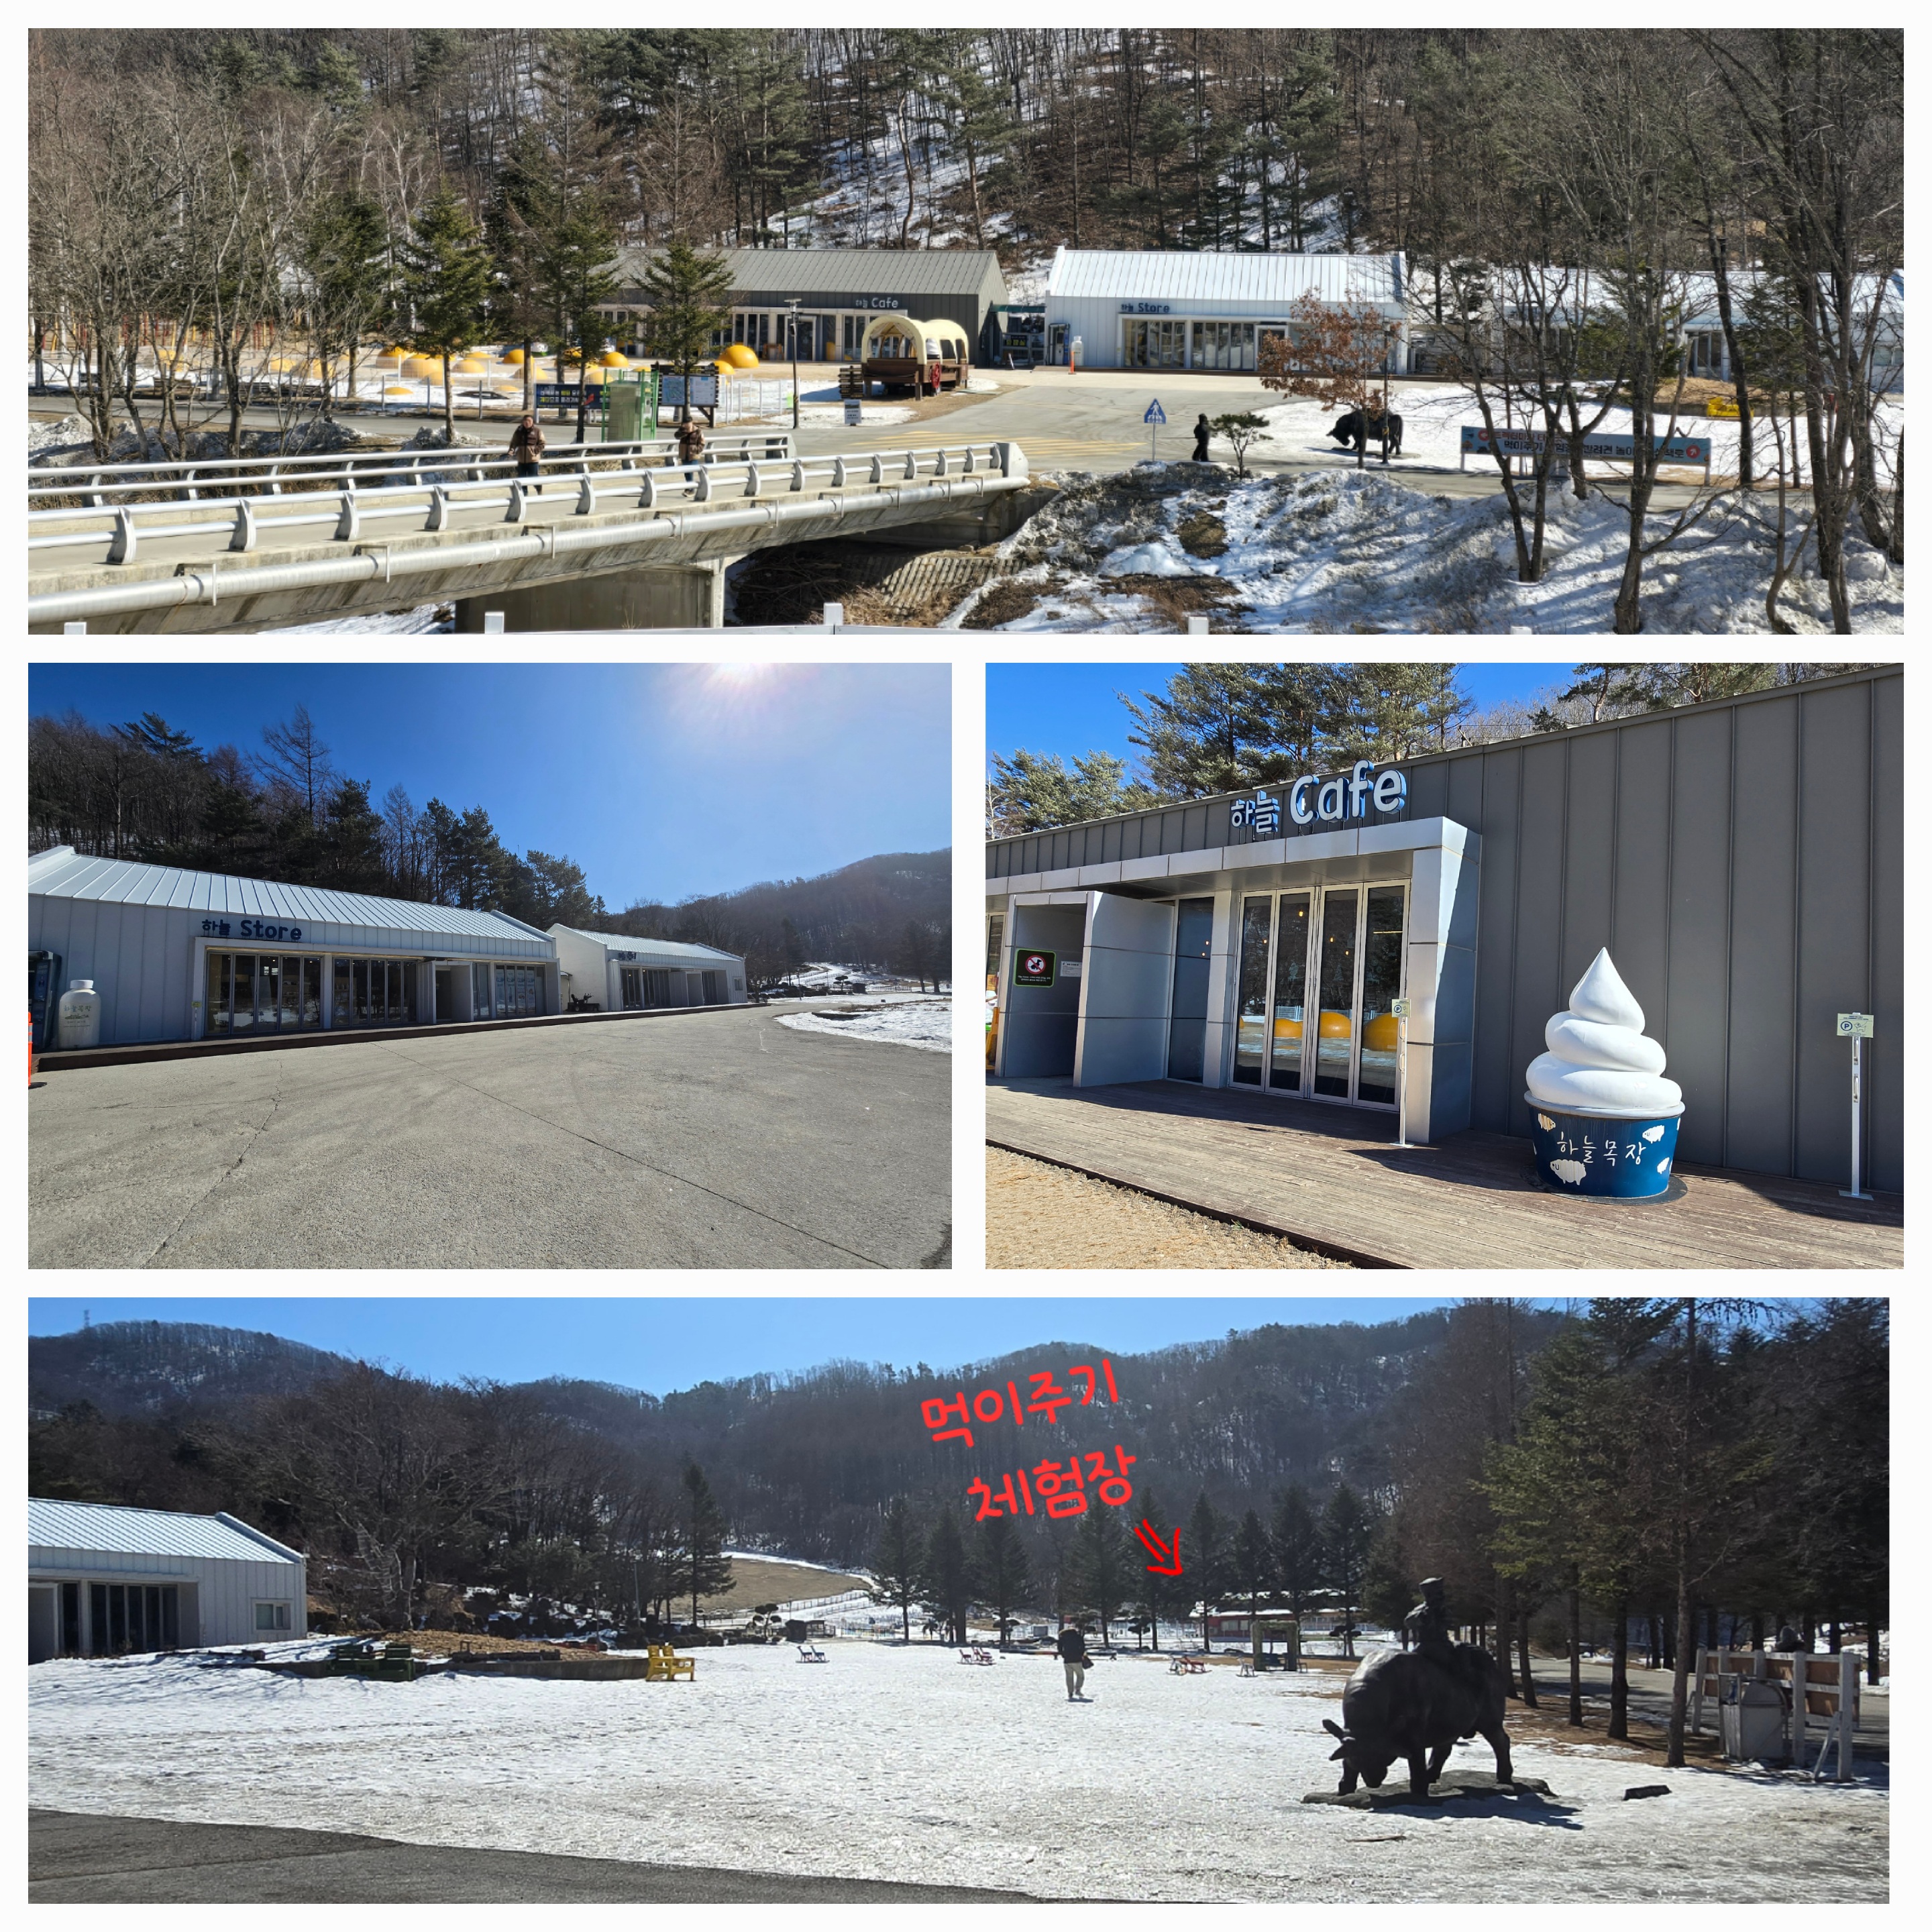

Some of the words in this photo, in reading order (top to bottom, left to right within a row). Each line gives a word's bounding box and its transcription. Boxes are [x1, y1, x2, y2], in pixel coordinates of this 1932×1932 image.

[871, 297, 898, 308] Cafe
[1138, 302, 1170, 313] Store
[1504, 440, 1543, 451] 먹이주기
[1615, 445, 1635, 455] 놀이
[1230, 790, 1280, 834] 하늘
[1289, 759, 1407, 826] Cafe
[202, 919, 231, 936] 하늘
[240, 920, 302, 940] Store
[1557, 1131, 1646, 1167] 하늘목장
